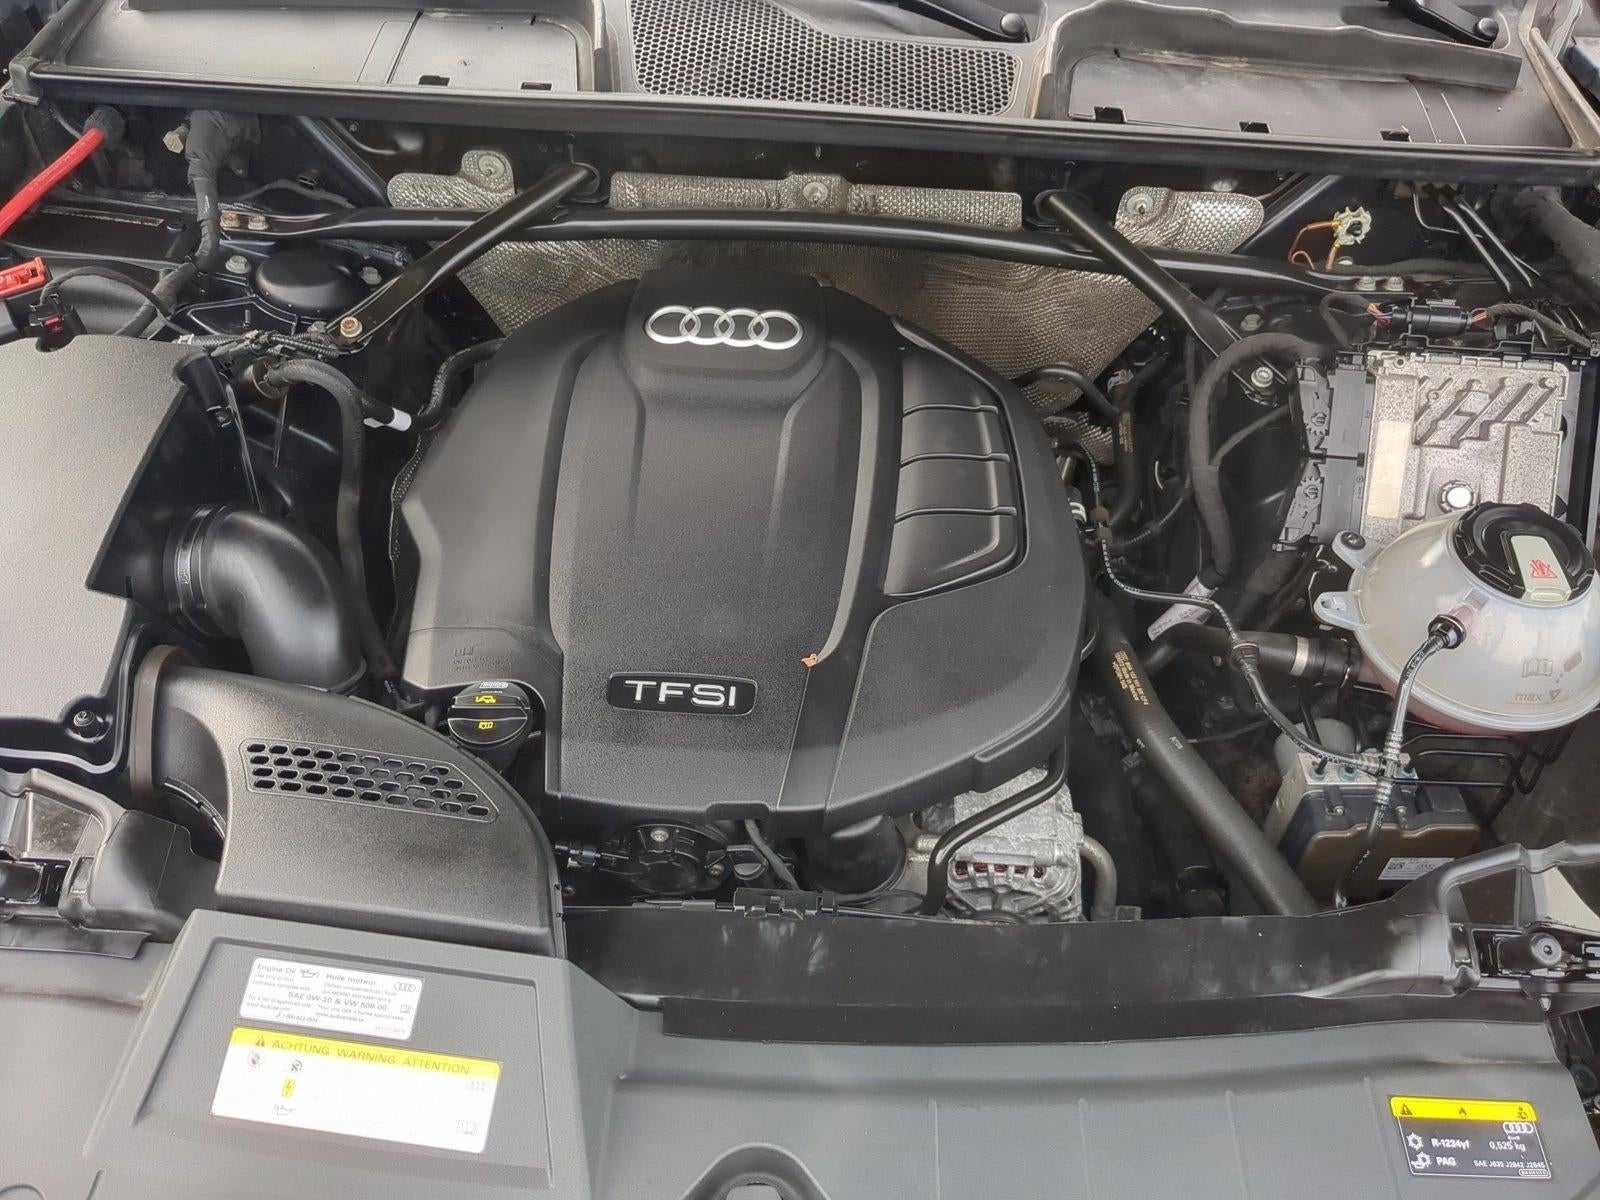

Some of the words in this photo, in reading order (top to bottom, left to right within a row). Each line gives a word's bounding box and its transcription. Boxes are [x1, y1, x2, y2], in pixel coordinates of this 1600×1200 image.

[624, 680, 736, 708] TFSI
[1514, 692, 1543, 702] max
[257, 964, 283, 975] Engine
[285, 967, 297, 975] Oil
[326, 973, 346, 982] Huile
[347, 976, 377, 985] moteur
[288, 991, 304, 999] SAE
[306, 994, 333, 1003] 0W-20
[344, 999, 358, 1007] VW
[272, 1039, 330, 1056] ACHTUNG
[336, 1048, 396, 1065] WARNING
[402, 1057, 471, 1075] ATTENTION
[1431, 1138, 1470, 1150] R-1234yf
[1489, 1140, 1514, 1151] 0,525
[1514, 1141, 1526, 1152] kg
[1436, 1156, 1457, 1167] PAG
[1473, 1159, 1488, 1168] SAE
[1488, 1160, 1504, 1168] J639
